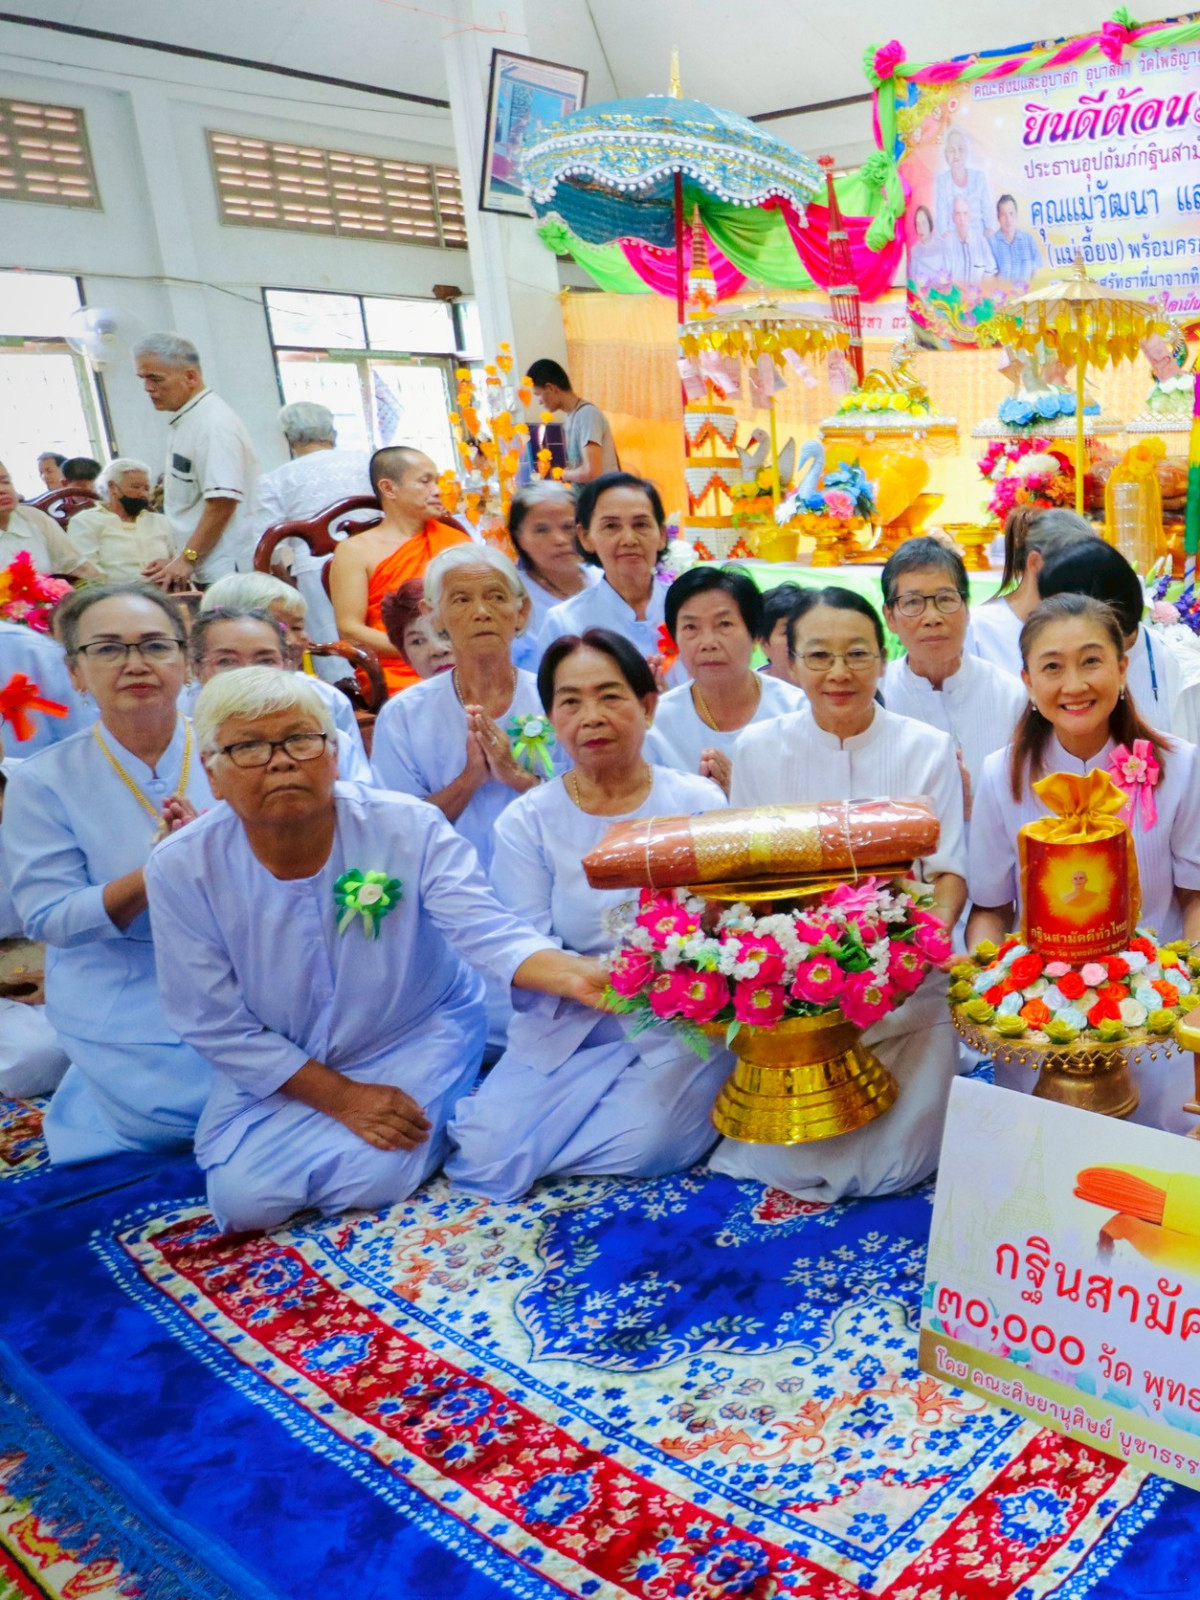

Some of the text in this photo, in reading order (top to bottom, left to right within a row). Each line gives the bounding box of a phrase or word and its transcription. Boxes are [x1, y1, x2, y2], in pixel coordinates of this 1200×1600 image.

[1031, 179, 1160, 242] คุณแม่วัฒนา
[938, 1287, 1086, 1367] ๓๐,๐๐๐
[1098, 1342, 1134, 1387] วัด
[935, 1347, 968, 1378] โดย
[972, 1370, 1113, 1440] คณะศิษยานุศิษย์
